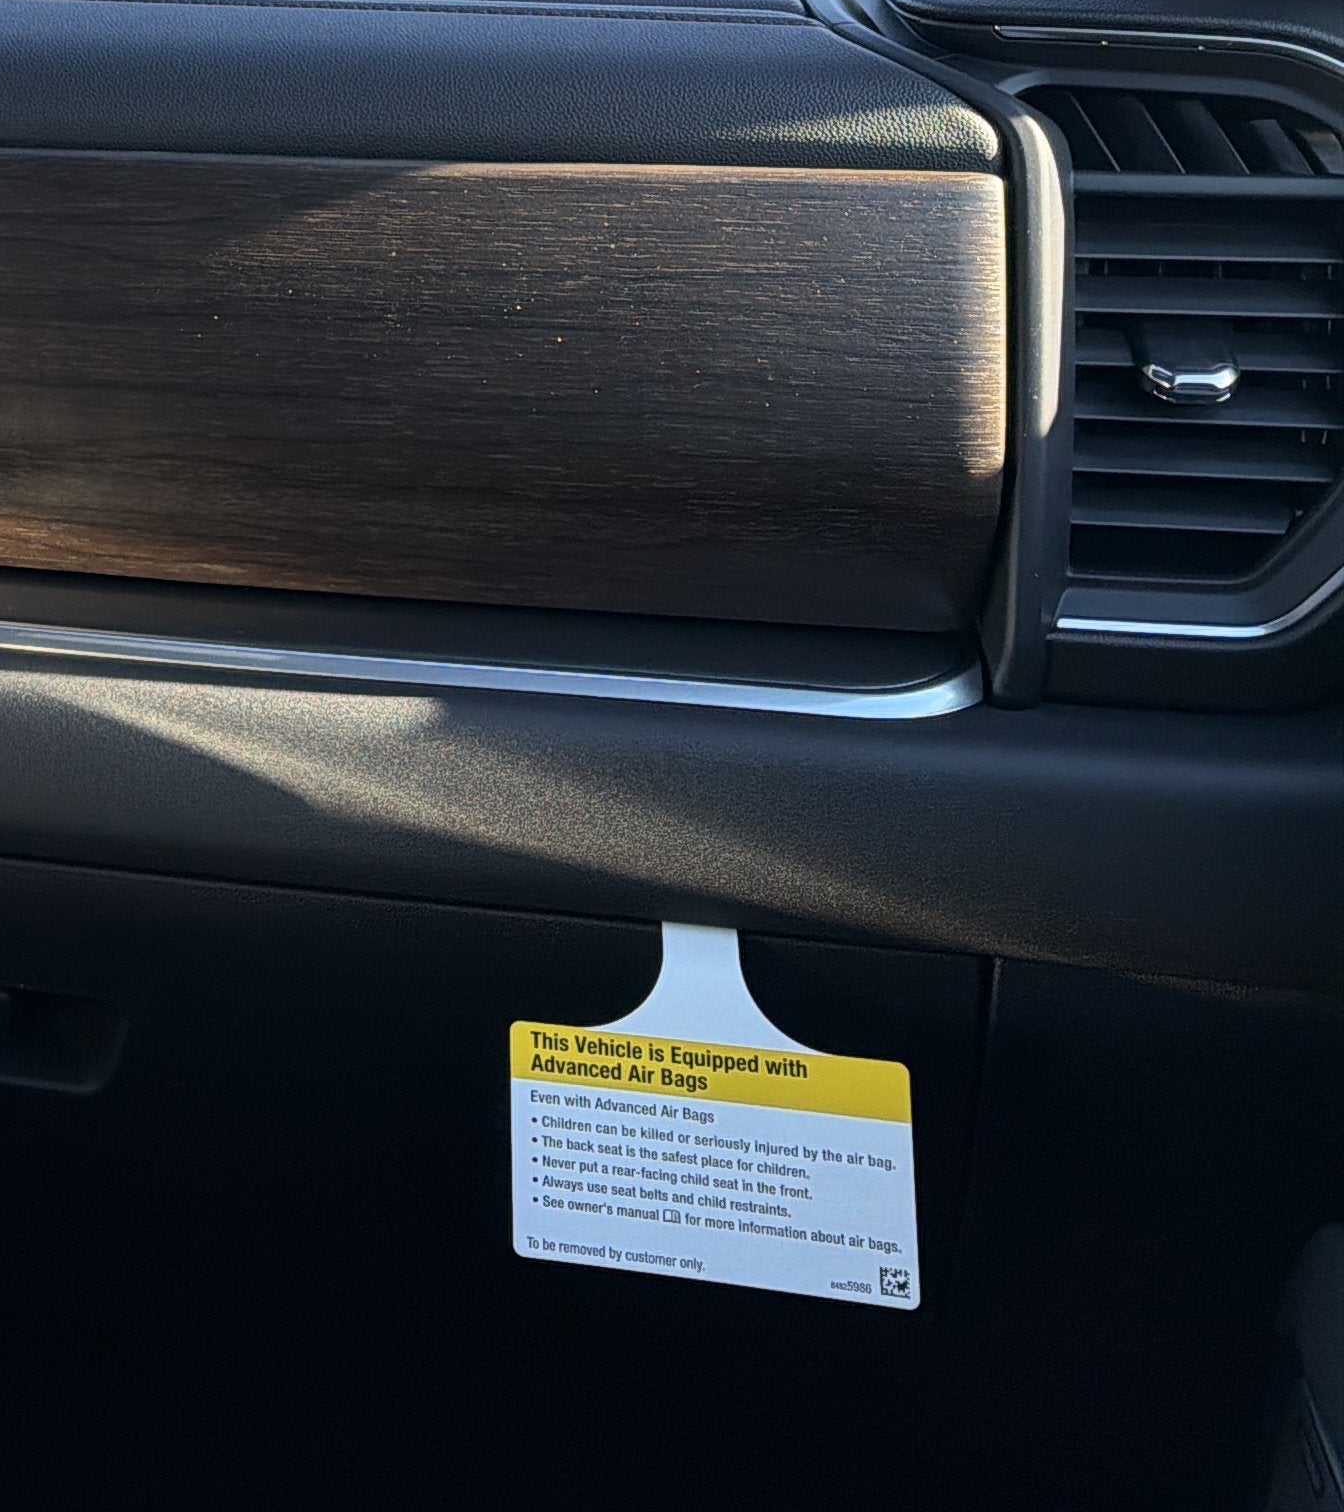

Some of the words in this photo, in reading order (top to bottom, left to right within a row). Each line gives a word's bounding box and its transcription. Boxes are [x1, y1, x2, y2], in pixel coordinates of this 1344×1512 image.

[530, 1031, 569, 1052] This
[574, 1035, 643, 1060] Vehicle
[648, 1043, 664, 1062] is
[671, 1045, 759, 1074] Equipped
[765, 1057, 808, 1079] with
[530, 1053, 622, 1081] Advanced
[627, 1064, 655, 1084] Air
[661, 1068, 708, 1093] Bags
[531, 1090, 560, 1105] Even
[564, 1094, 591, 1109] with
[595, 1097, 657, 1116] Advanced
[661, 1105, 679, 1119] Air
[682, 1107, 714, 1125] Bags
[541, 1135, 563, 1149] The
[566, 1138, 594, 1153] back
[598, 1144, 623, 1156] seat
[626, 1145, 636, 1157] is
[639, 1147, 658, 1160] the
[661, 1151, 698, 1165] safest
[701, 1155, 733, 1169] place
[737, 1159, 754, 1172] for
[757, 1161, 810, 1179] children.
[542, 1115, 591, 1132] Children
[595, 1124, 617, 1135] can
[621, 1125, 636, 1137] be
[640, 1127, 673, 1142] killed
[678, 1134, 691, 1144] or
[694, 1135, 751, 1153] seriously
[755, 1140, 798, 1157] injured
[803, 1146, 818, 1162] by
[822, 1149, 842, 1162] the
[847, 1152, 864, 1165] air
[868, 1155, 896, 1171] bag.
[542, 1155, 576, 1170] Never
[579, 1161, 598, 1174] put
[601, 1165, 609, 1174] a
[612, 1166, 677, 1185] rear-facing
[681, 1172, 709, 1186] child
[713, 1178, 739, 1190] seat
[742, 1179, 753, 1192] in
[757, 1182, 776, 1195] the
[779, 1184, 812, 1200] front.
[542, 1175, 584, 1192] Always
[587, 1182, 608, 1194] use
[611, 1186, 636, 1198] seat
[640, 1187, 668, 1201] belts
[672, 1193, 694, 1205] and
[698, 1195, 726, 1209] child
[730, 1201, 791, 1218] restraints.
[543, 1195, 564, 1209] See
[567, 1201, 613, 1215] owner's
[617, 1207, 659, 1221] manual
[685, 1213, 701, 1226] for
[705, 1218, 735, 1230] more
[738, 1219, 807, 1240] information
[811, 1230, 845, 1245] about
[849, 1235, 865, 1248] air
[868, 1237, 902, 1254] bags.
[527, 1236, 539, 1249] To
[542, 1238, 556, 1251] be
[559, 1243, 606, 1258] removed
[609, 1246, 622, 1262] by
[625, 1251, 677, 1267] customer
[680, 1258, 705, 1273] only.
